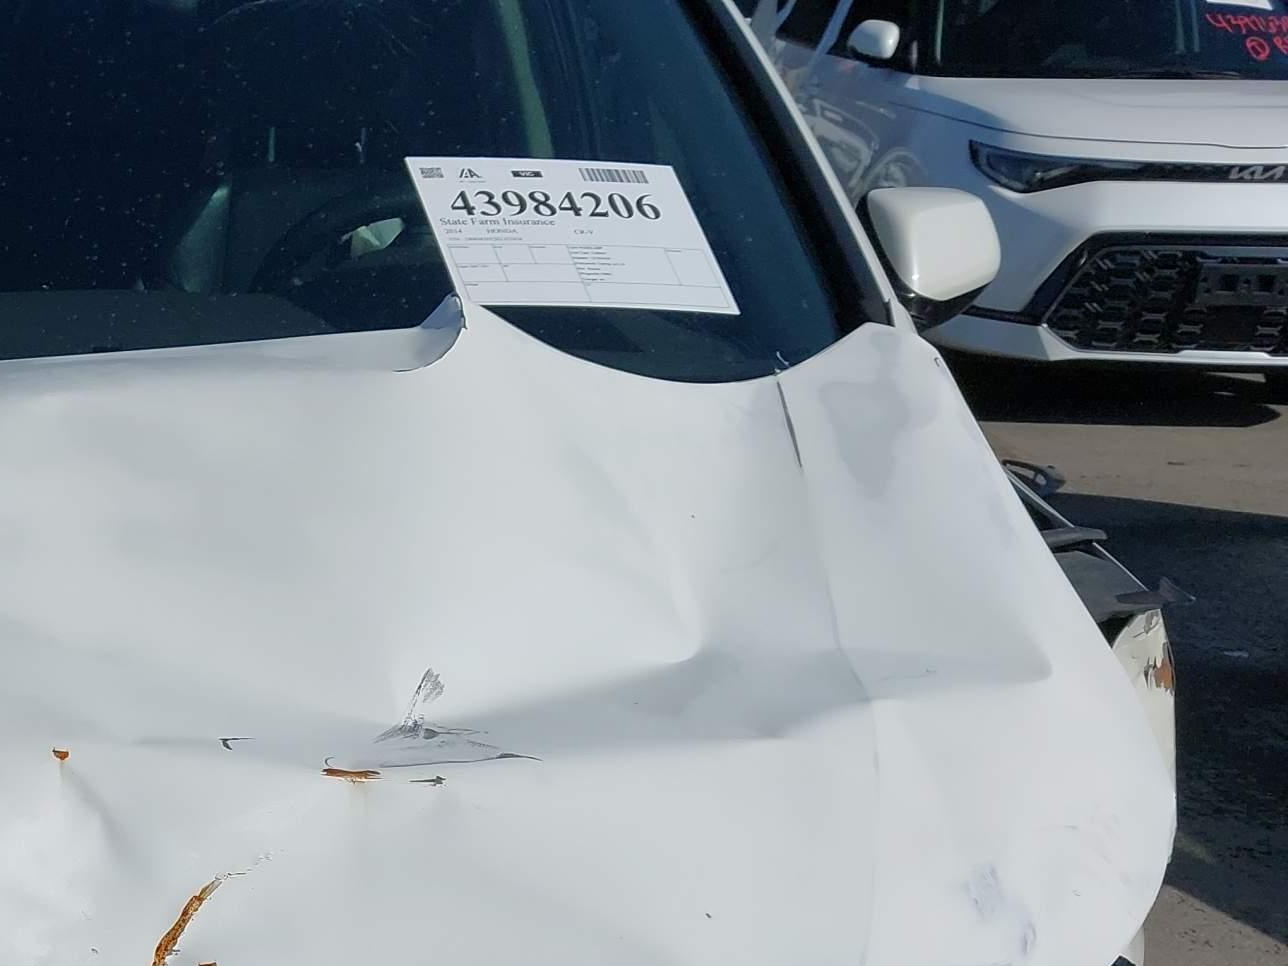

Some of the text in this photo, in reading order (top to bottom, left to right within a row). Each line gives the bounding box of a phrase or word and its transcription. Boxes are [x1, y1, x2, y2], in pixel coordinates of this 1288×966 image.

[450, 189, 662, 220] 43984206
[439, 217, 556, 226] State Farm Insurance
